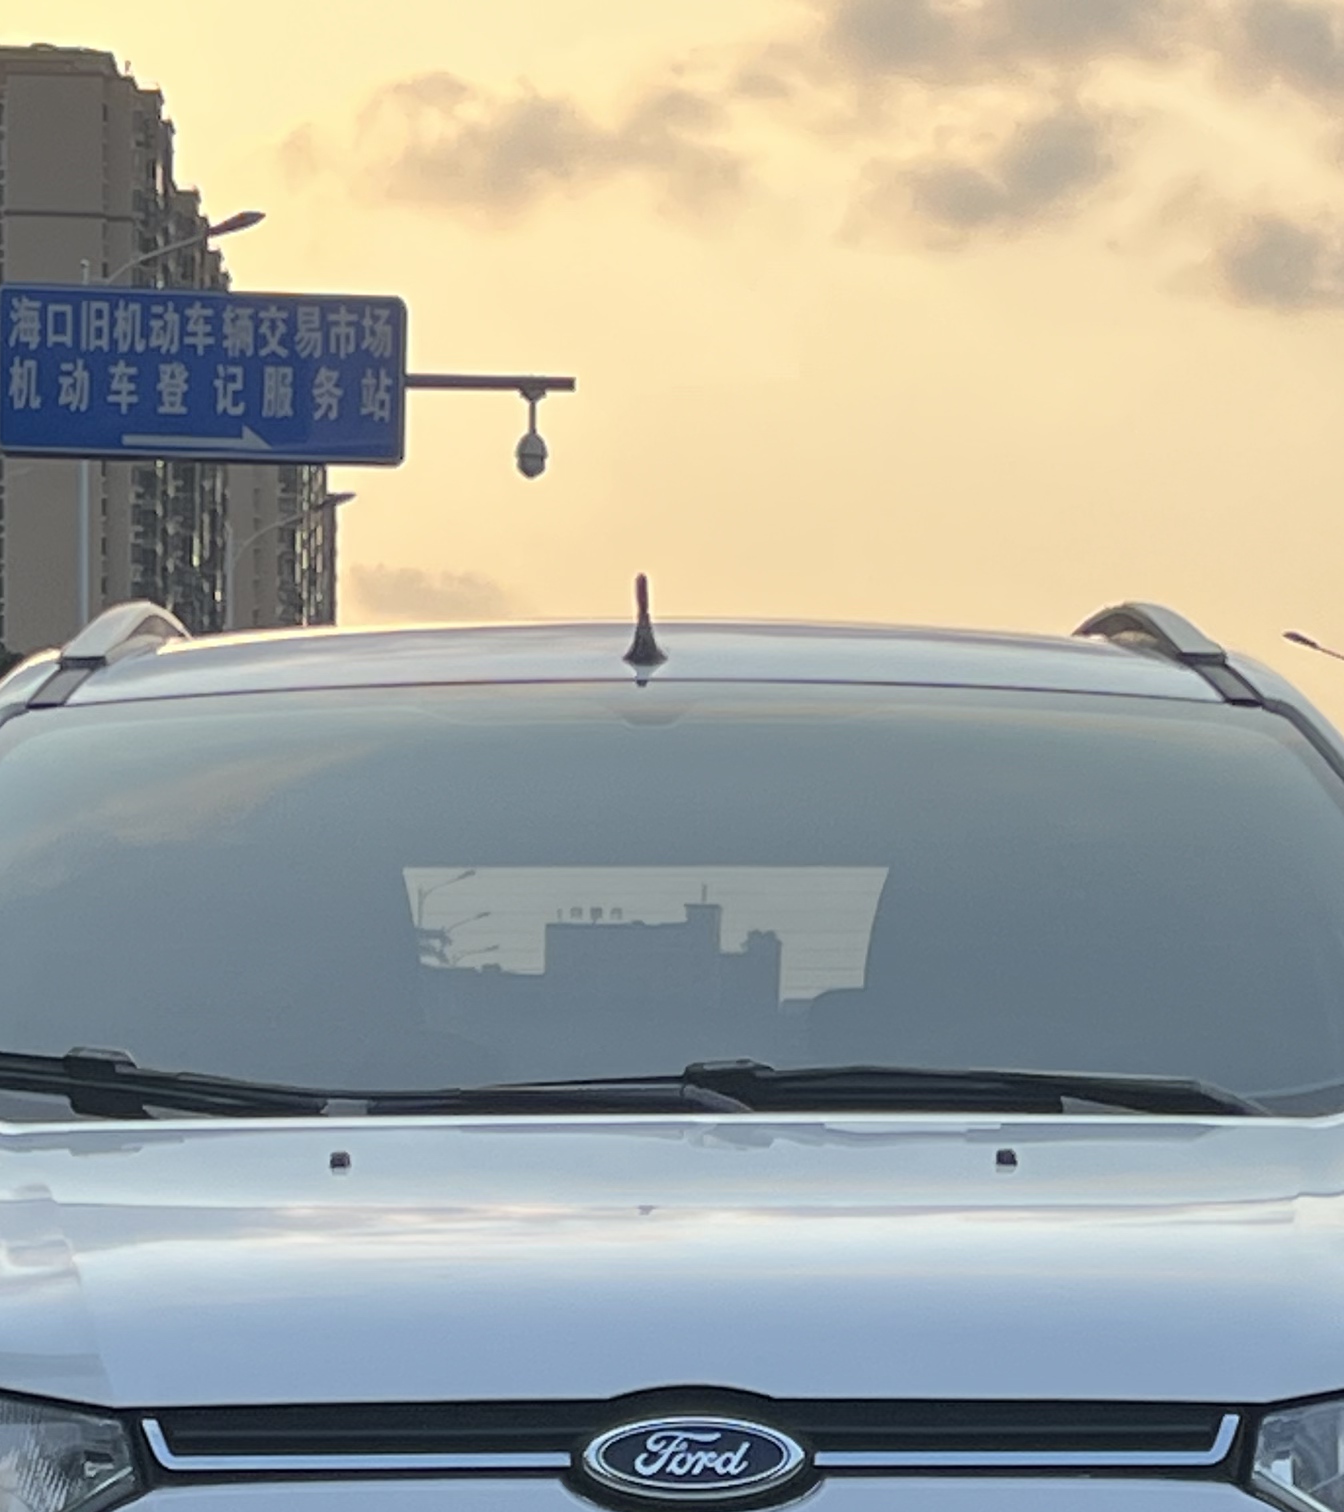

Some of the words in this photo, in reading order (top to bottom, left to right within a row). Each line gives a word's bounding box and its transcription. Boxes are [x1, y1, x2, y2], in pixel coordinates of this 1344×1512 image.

[9, 297, 393, 359] 海口旧机动车辆交易市场
[9, 360, 392, 422] 机动车登记服务站
[634, 1431, 750, 1475] Ford
